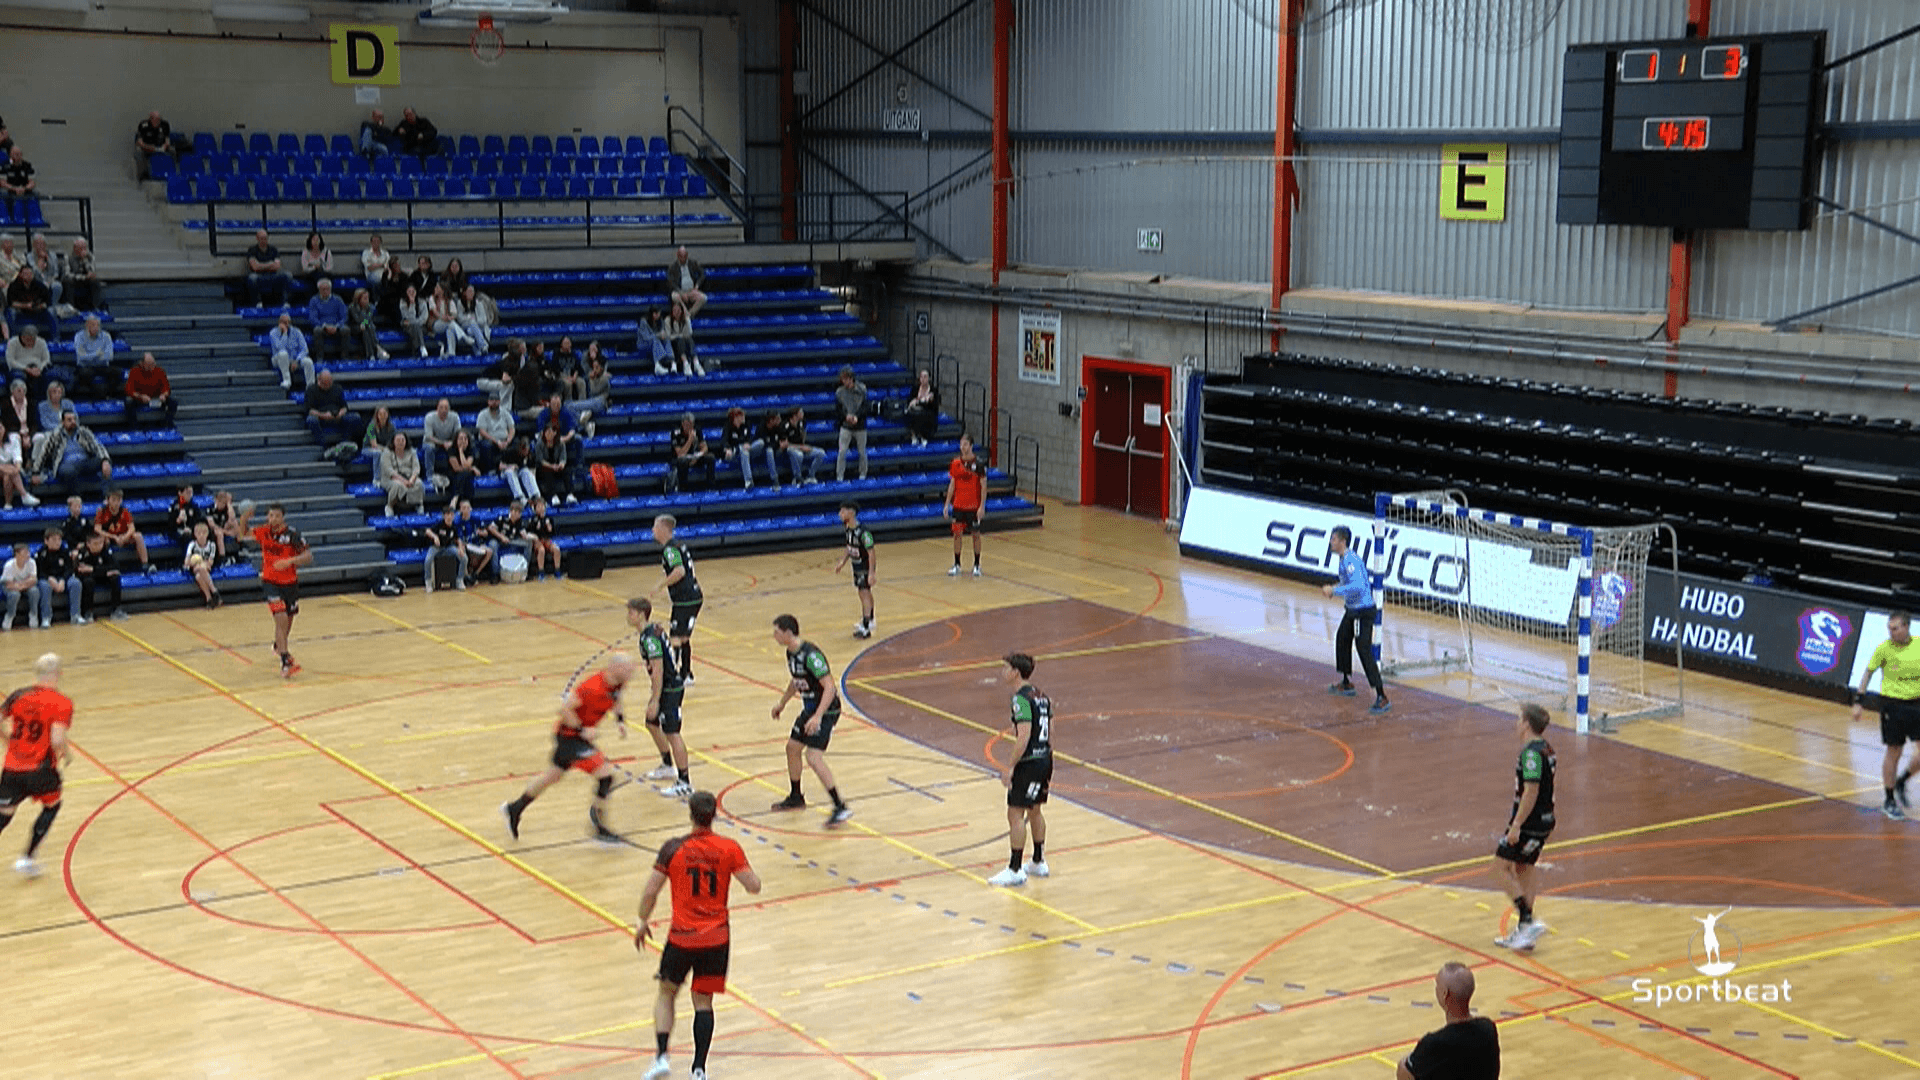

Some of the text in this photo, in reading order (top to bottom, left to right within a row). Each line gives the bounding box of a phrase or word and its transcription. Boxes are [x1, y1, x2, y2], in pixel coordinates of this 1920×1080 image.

[347, 31, 385, 78] D
[1724, 48, 1741, 79] 3
[885, 110, 918, 129] UITGANG
[1457, 152, 1489, 210] E
[1680, 585, 1745, 620] HUBO
[1651, 616, 1757, 661] HANDBAL
[686, 867, 718, 897] 11
